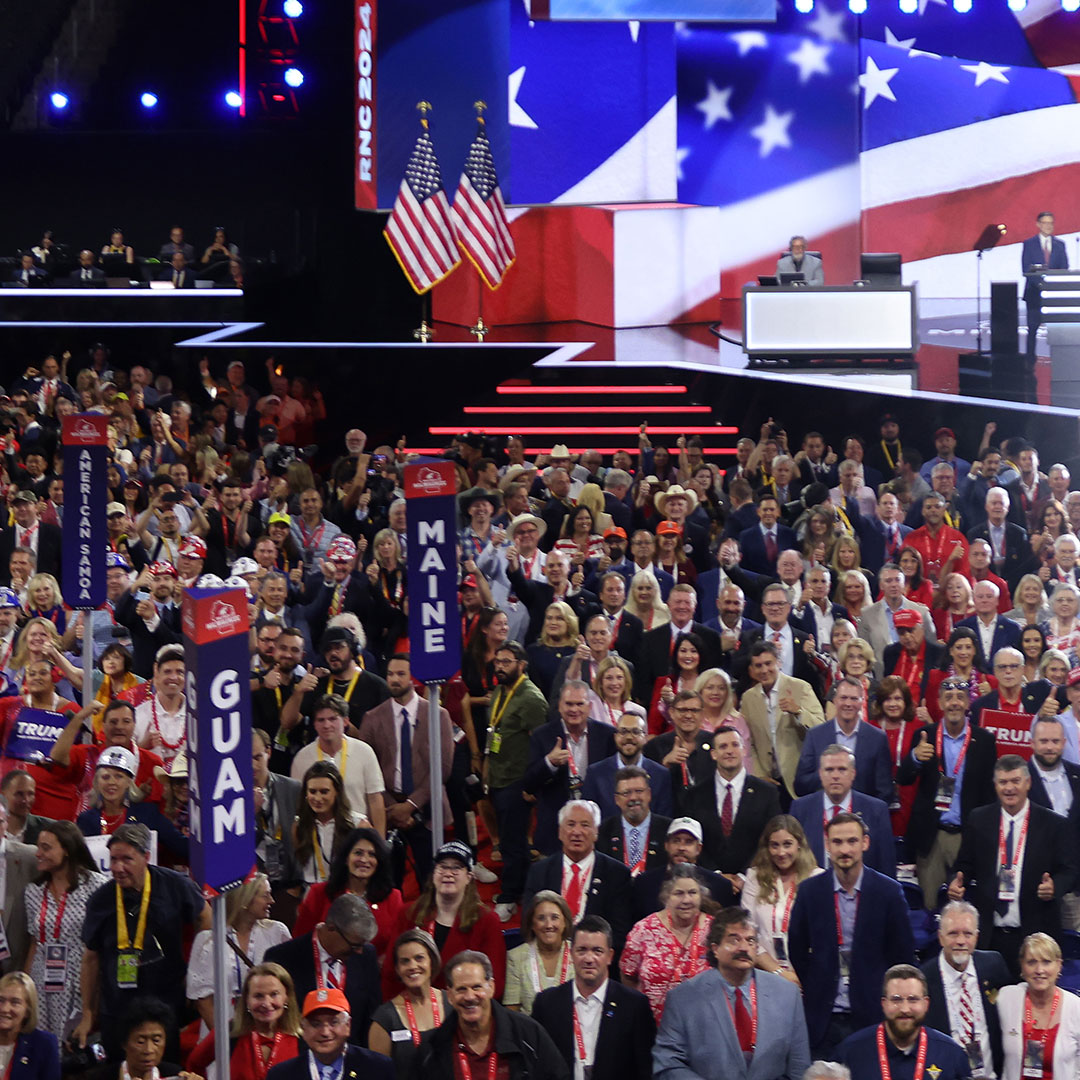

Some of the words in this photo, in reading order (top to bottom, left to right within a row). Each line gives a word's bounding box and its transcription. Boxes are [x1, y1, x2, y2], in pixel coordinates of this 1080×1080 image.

[358, 0, 373, 100] 2024
[358, 102, 372, 182] RNC
[79, 449, 92, 539] AMERICAN
[79, 543, 93, 601] SAMOA
[417, 519, 446, 654] MAINE
[16, 721, 65, 739] TRUM
[186, 669, 202, 844] GUAM
[210, 668, 247, 845] GUAM
